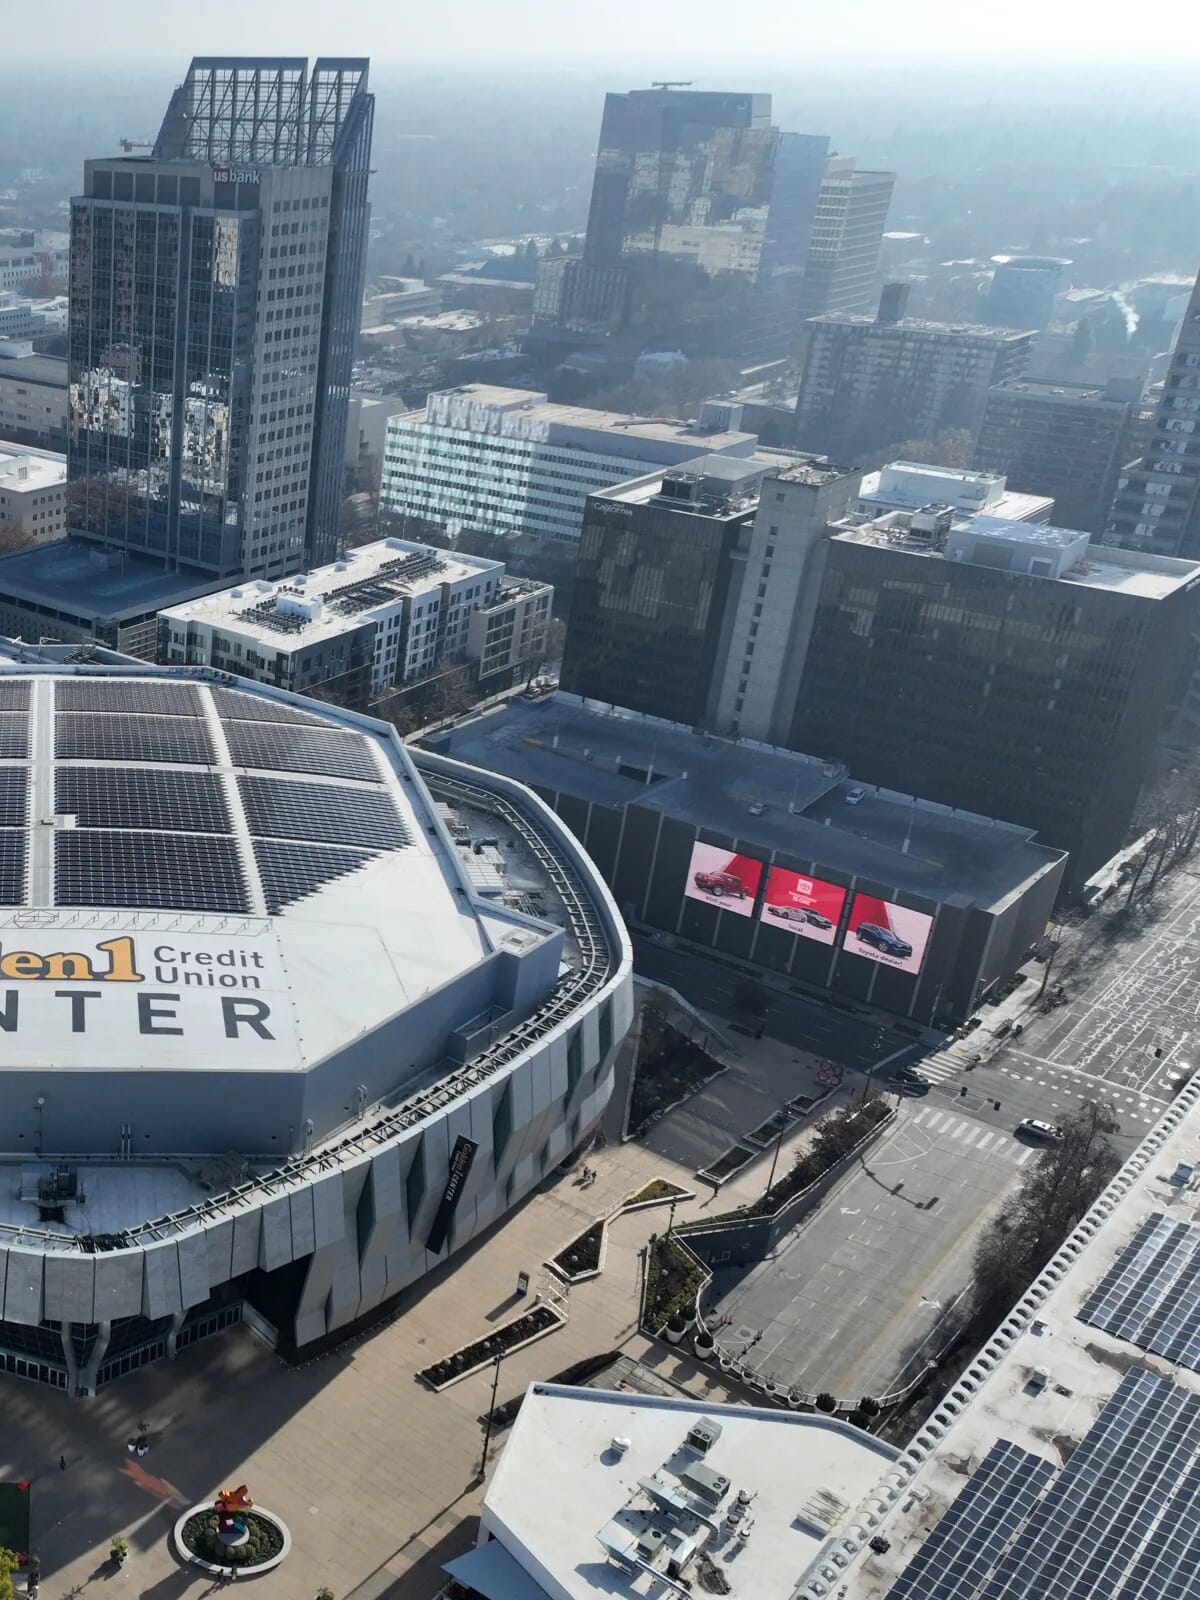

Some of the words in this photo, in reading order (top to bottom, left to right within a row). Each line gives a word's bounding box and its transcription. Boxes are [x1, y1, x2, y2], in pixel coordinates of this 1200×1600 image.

[153, 944, 265, 970] Credit
[857, 947, 880, 959] Toyota
[154, 965, 262, 990] Union
